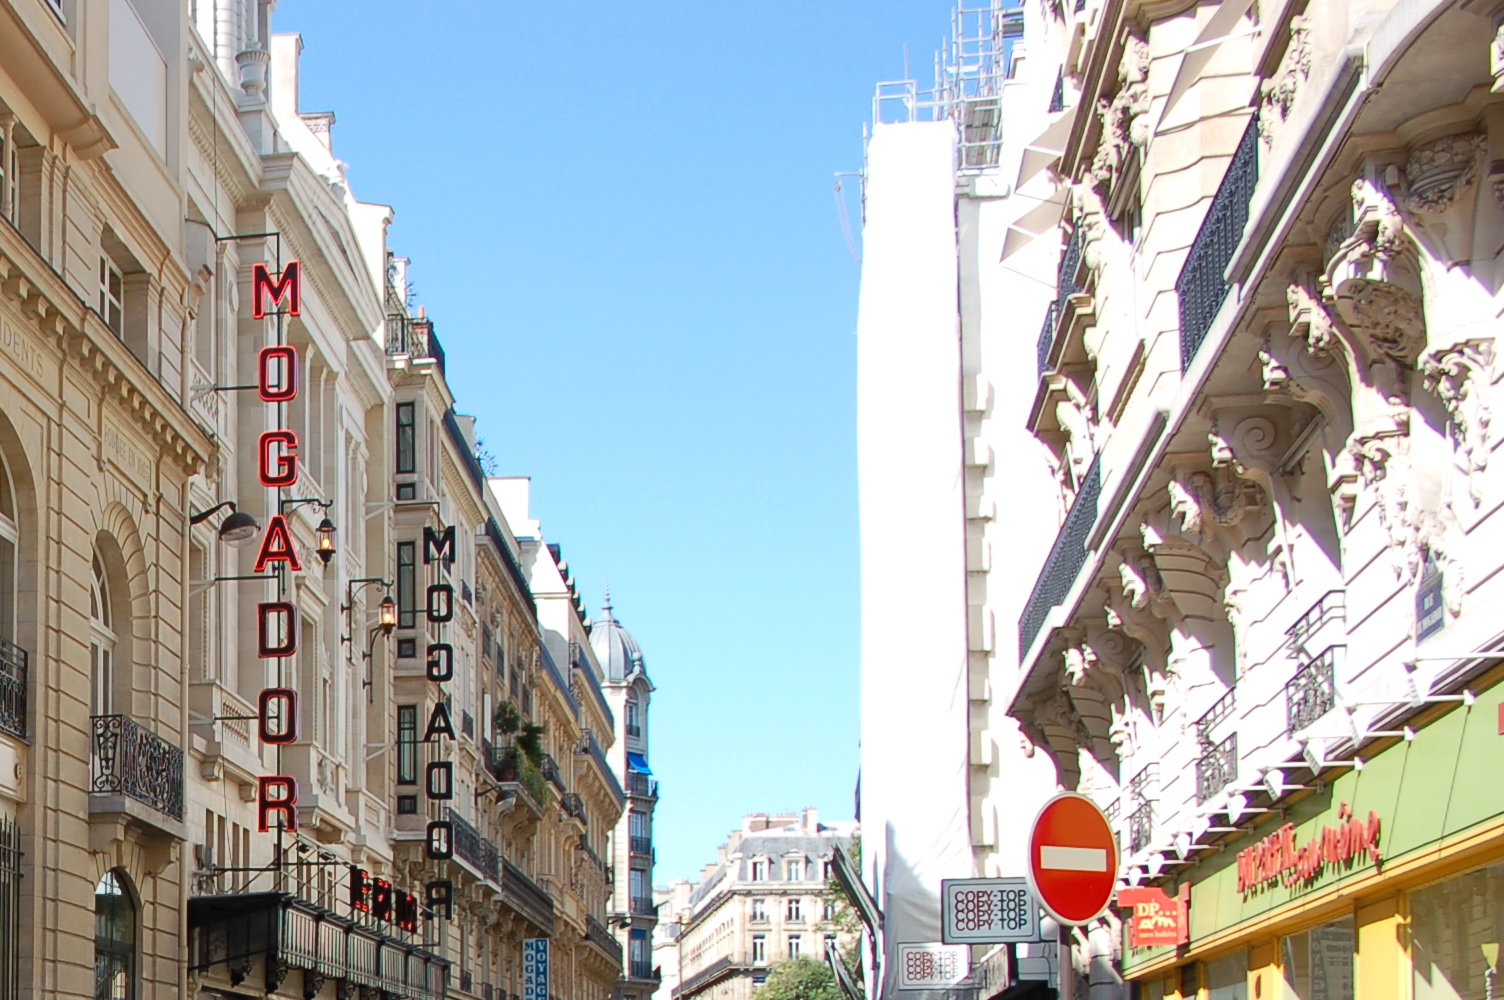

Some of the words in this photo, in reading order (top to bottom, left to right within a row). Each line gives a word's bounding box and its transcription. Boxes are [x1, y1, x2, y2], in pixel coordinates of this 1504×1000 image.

[252, 260, 302, 833] MOGADOR
[954, 889, 1027, 901] COPY-TOP
[954, 900, 1027, 911] COPY-TOP
[954, 910, 1027, 921] COPY-TOP
